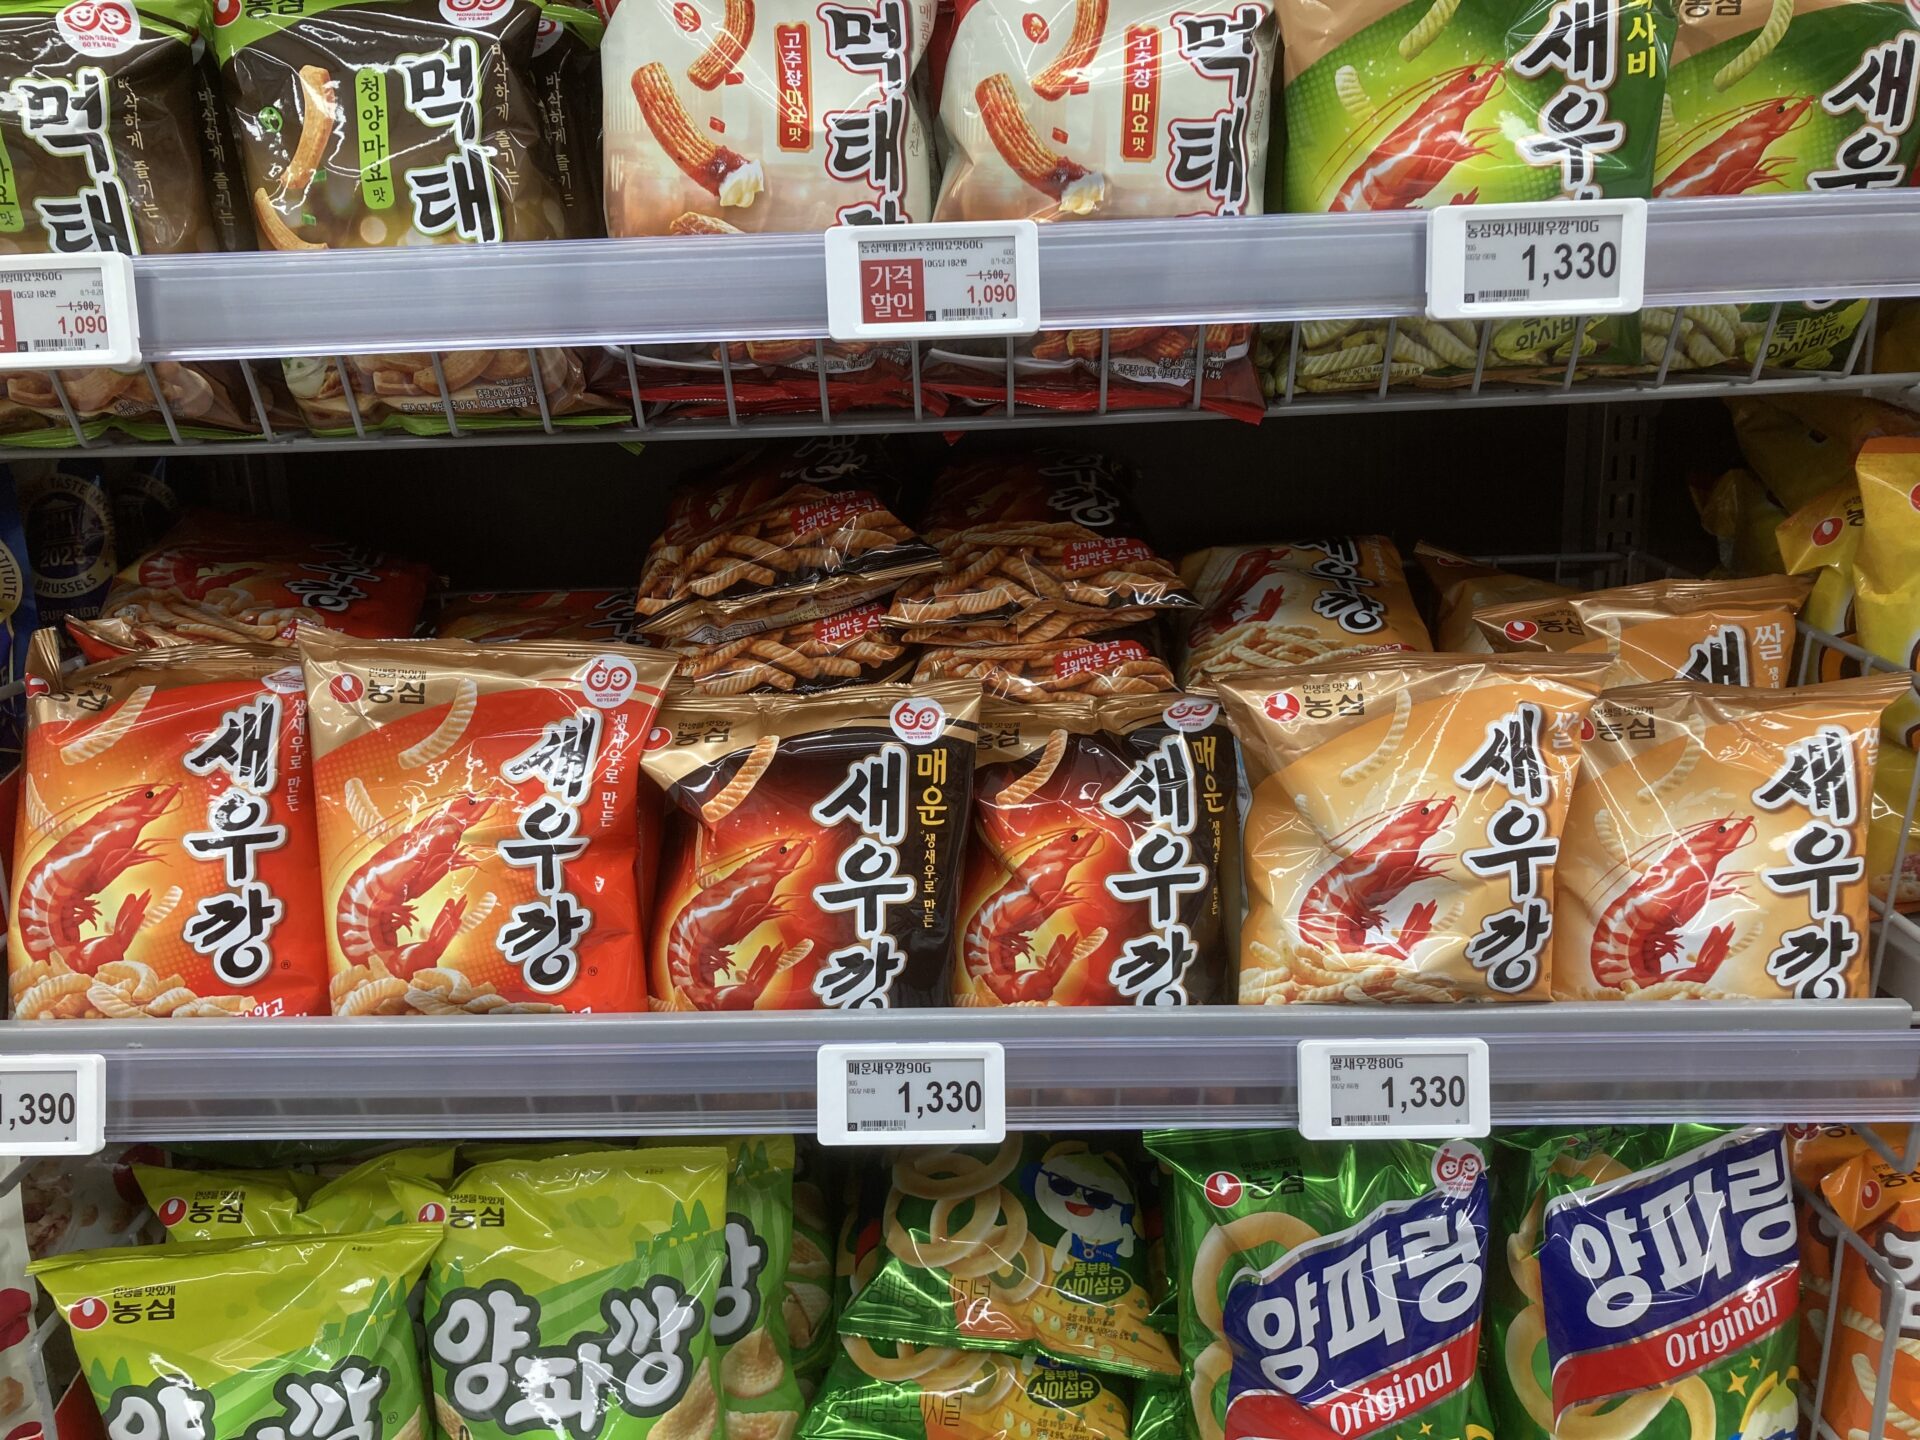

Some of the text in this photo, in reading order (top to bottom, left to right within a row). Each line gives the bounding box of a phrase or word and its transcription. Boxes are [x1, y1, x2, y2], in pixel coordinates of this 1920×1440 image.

[1626, 0, 1657, 79] 사비
[1174, 7, 1258, 217] 먹태
[402, 43, 497, 243] 먹태
[131, 160, 160, 219] 즐기는
[1466, 219, 1600, 239] 농심와사비새우깡70G
[869, 265, 913, 291] 가격
[978, 269, 1004, 282] 1,500
[1521, 241, 1617, 287] 1,330
[870, 293, 914, 318] 할인
[966, 284, 1016, 307] 1,090
[58, 315, 108, 337] 1,090
[35, 574, 98, 594] BRUSSELS
[1752, 622, 1785, 661] 쌀
[367, 679, 425, 705] 농심
[1302, 682, 1331, 695] 인생을
[1303, 692, 1365, 719] 농심
[674, 726, 731, 747] 농심
[1596, 716, 1656, 742] 농심
[915, 747, 949, 827] 매운
[1192, 735, 1225, 814] 매운
[286, 776, 301, 813] 만든
[600, 791, 618, 828] 만든
[189, 701, 280, 979] 새우깡
[501, 716, 596, 986] 새우깡
[1460, 708, 1558, 990] 새우깡
[818, 751, 909, 1009] 새우깡
[1108, 742, 1202, 1007] 새우깡
[1759, 731, 1860, 1000] 새우깡
[921, 898, 938, 929] 만든
[848, 1061, 932, 1076] 매운새우깡90G
[1330, 1056, 1404, 1071] 쌀새우깡80G
[897, 1080, 982, 1119] 1,330
[1381, 1075, 1466, 1114] 1,330
[479, 1194, 506, 1205] 맛있게
[1245, 1168, 1305, 1201] 농심
[188, 1201, 244, 1225] 농심
[450, 1204, 506, 1230] 농심
[1569, 1138, 1799, 1329] 양파링
[1074, 1262, 1111, 1276] 풍부한
[144, 1284, 177, 1298] 맛있게
[1247, 1209, 1483, 1395] 양파링
[111, 1297, 176, 1325] 농심
[1664, 1286, 1779, 1368] Original
[433, 1285, 696, 1433] 양파깡
[1329, 1350, 1454, 1437] Original
